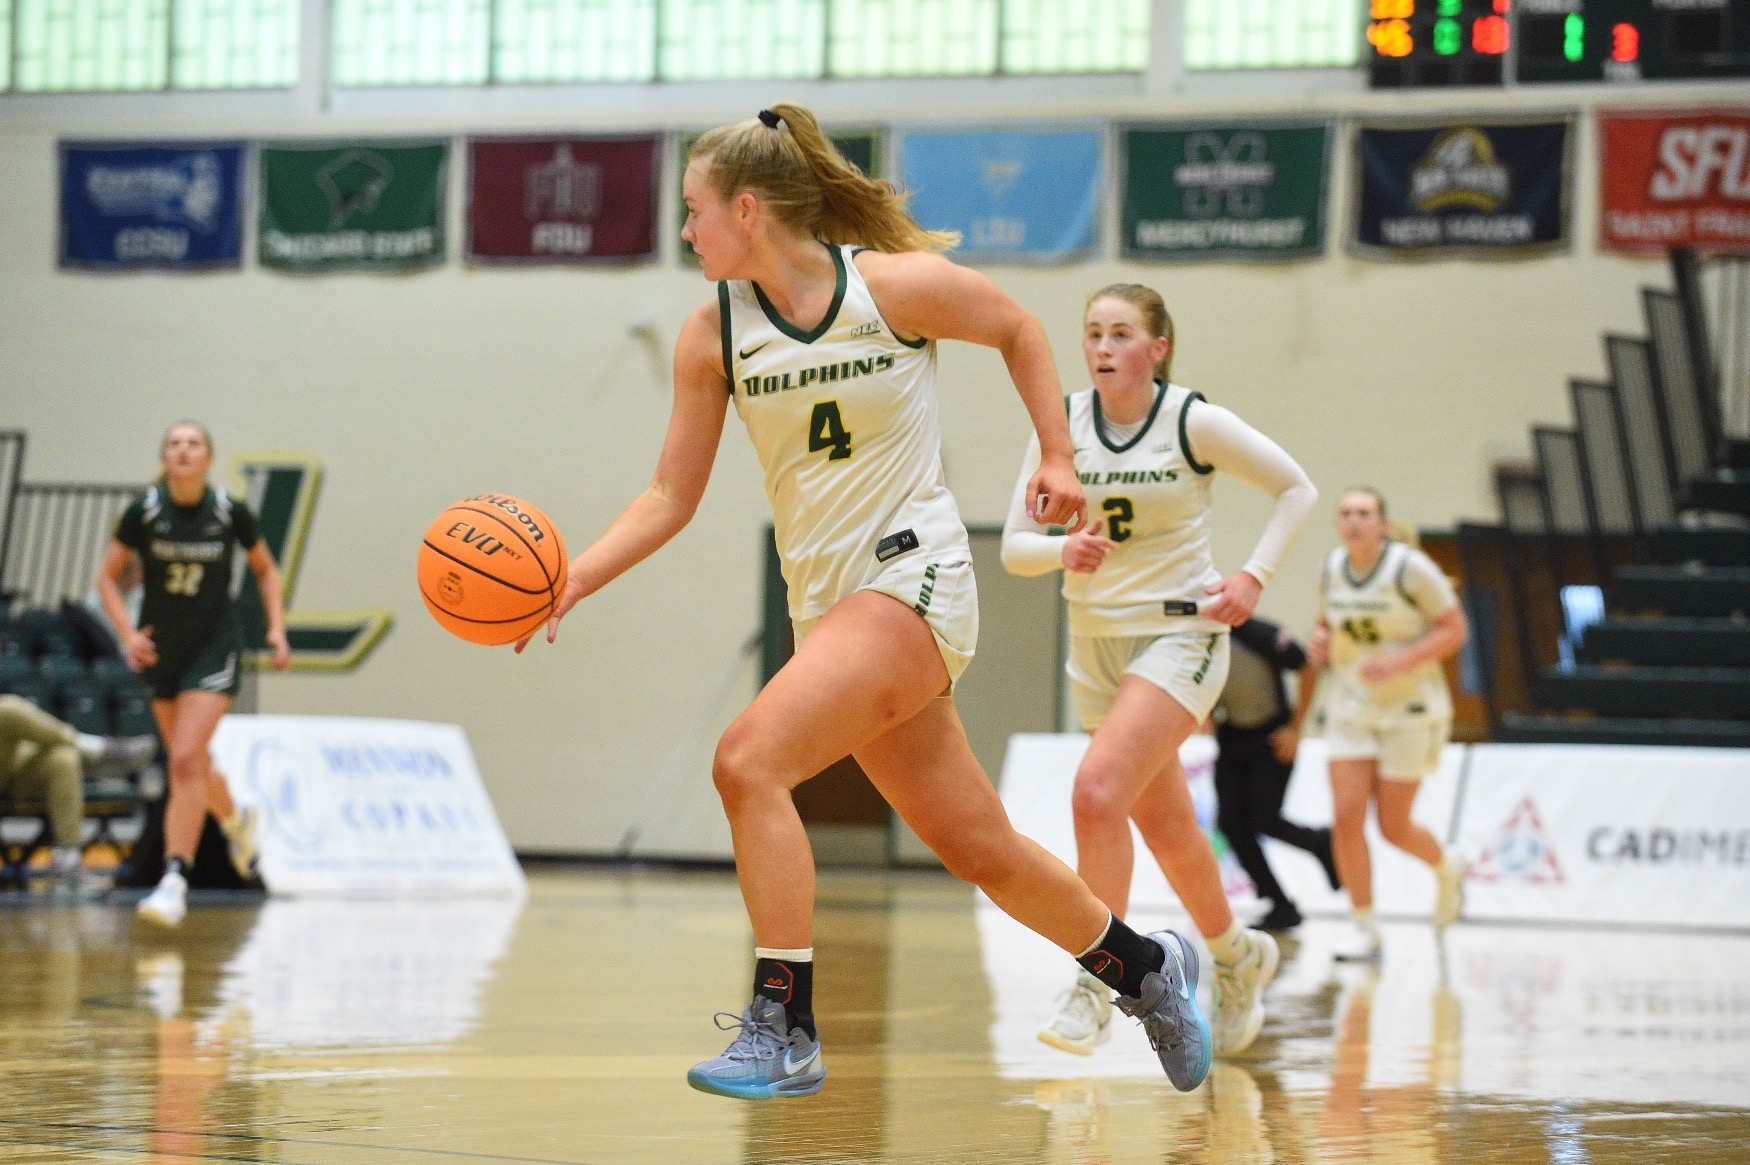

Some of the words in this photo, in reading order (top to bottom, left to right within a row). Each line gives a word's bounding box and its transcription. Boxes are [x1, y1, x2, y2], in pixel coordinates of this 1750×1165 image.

[531, 221, 593, 255] FDU
[743, 352, 896, 397] DOLPHINS
[806, 397, 854, 463] 4
[446, 521, 503, 557] EVO
[1101, 495, 1134, 544] 2
[901, 534, 912, 546] M
